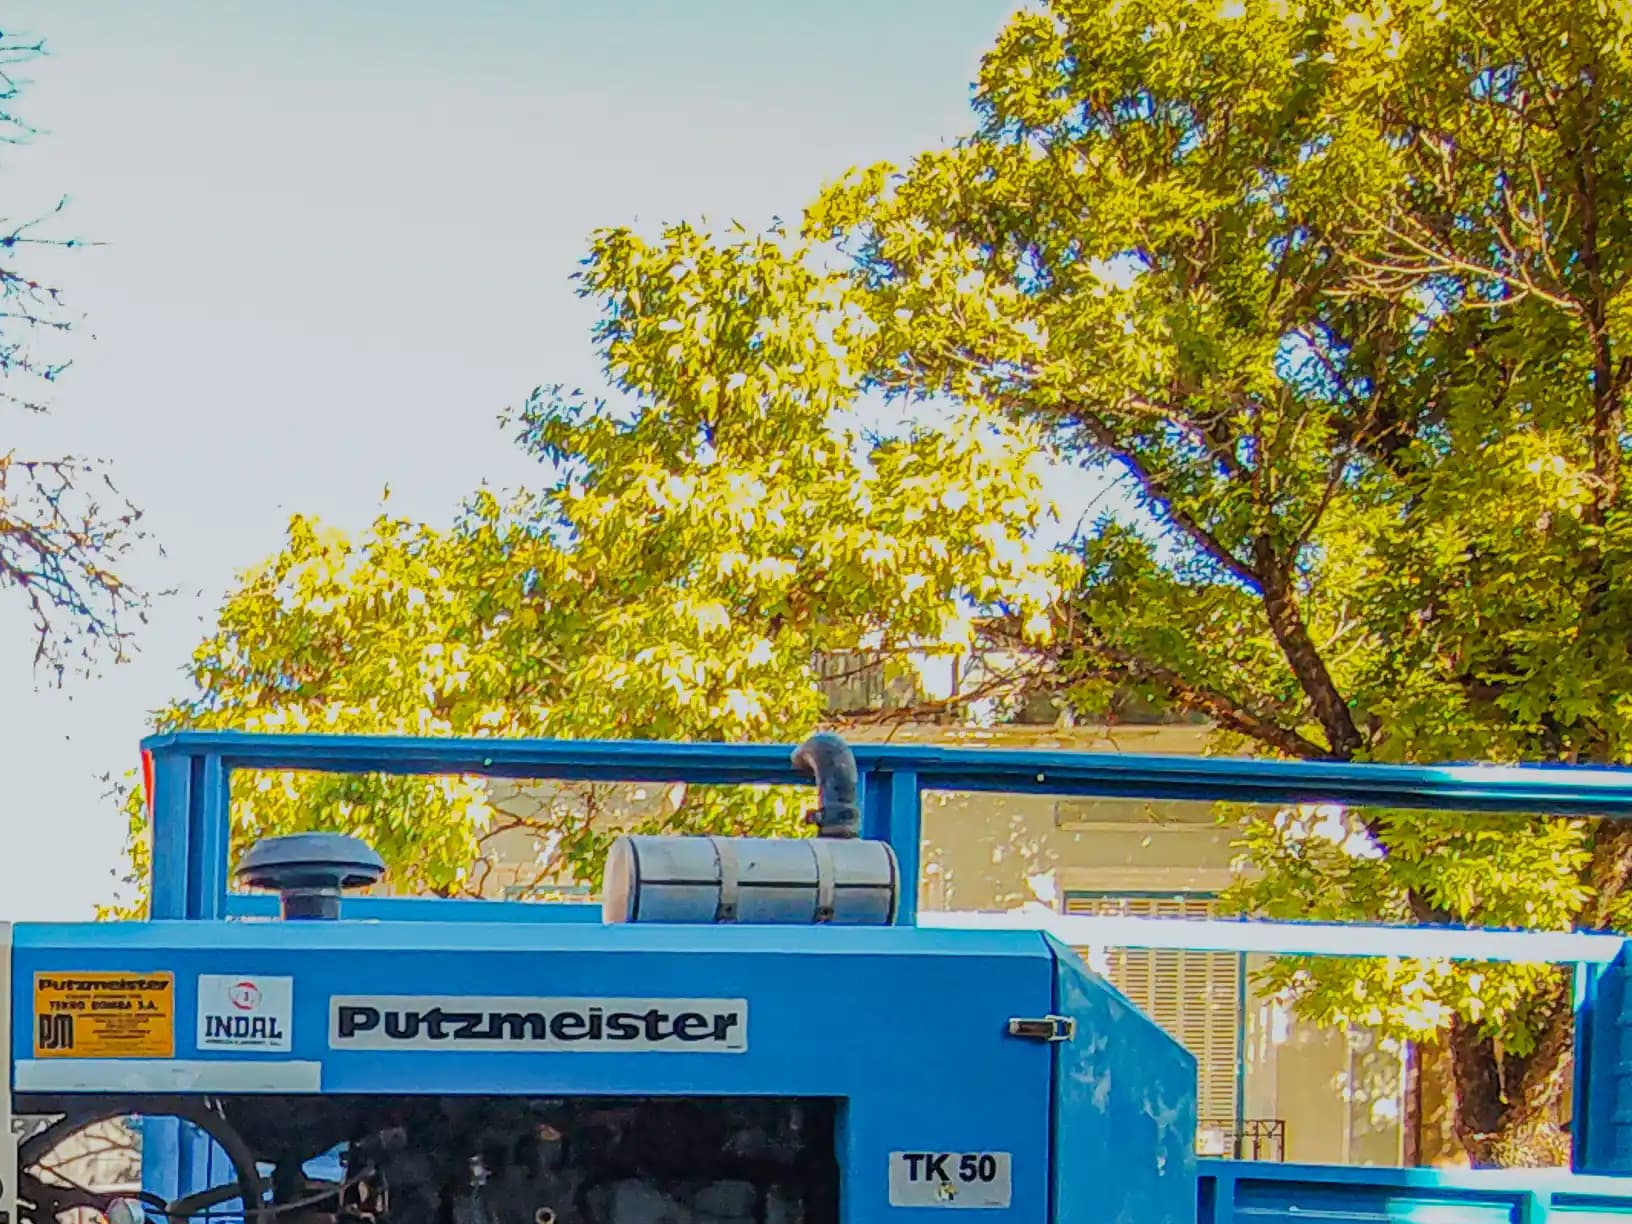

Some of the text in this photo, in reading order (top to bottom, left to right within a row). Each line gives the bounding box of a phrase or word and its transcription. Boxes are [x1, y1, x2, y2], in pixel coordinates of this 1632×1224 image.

[205, 1015, 282, 1039] INDAL
[338, 1005, 739, 1042] Putzmeister
[902, 1154, 997, 1183] TK 50
